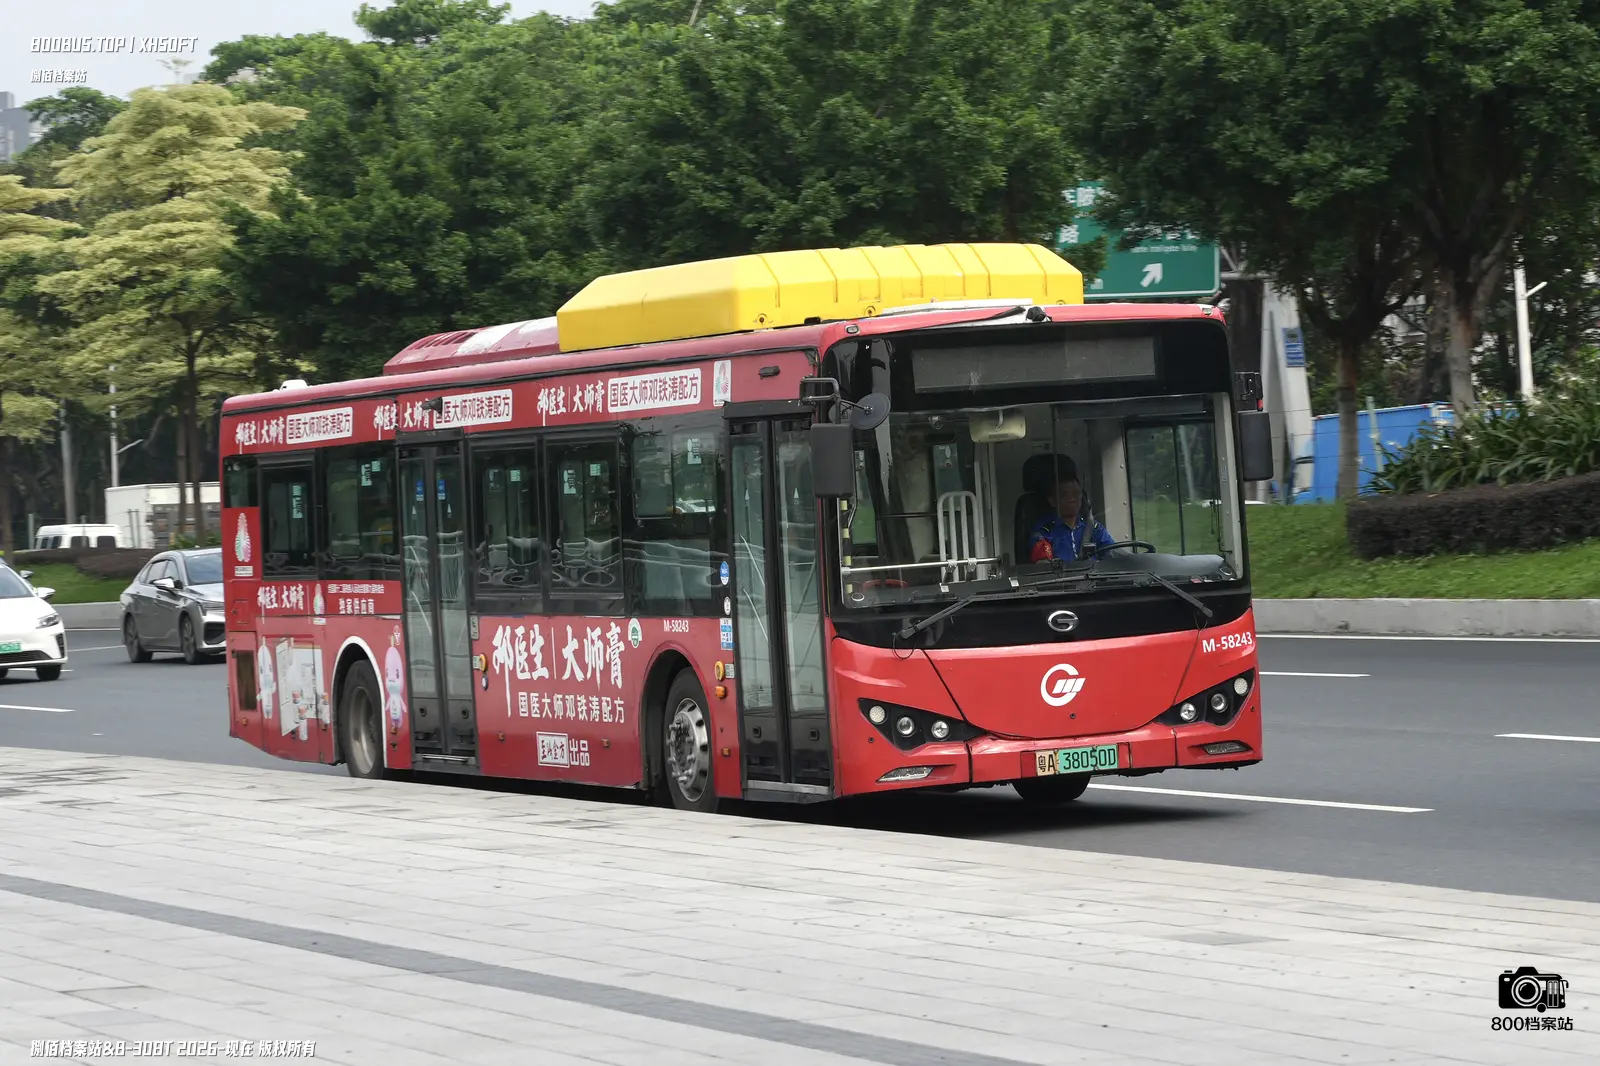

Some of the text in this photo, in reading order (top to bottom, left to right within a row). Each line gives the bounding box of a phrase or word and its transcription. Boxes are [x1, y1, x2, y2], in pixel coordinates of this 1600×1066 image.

[663, 619, 690, 633] M-58243
[1201, 631, 1253, 654] M-58243
[518, 691, 625, 724] 国医大师邓铁涛配方
[569, 738, 590, 767] 出品
